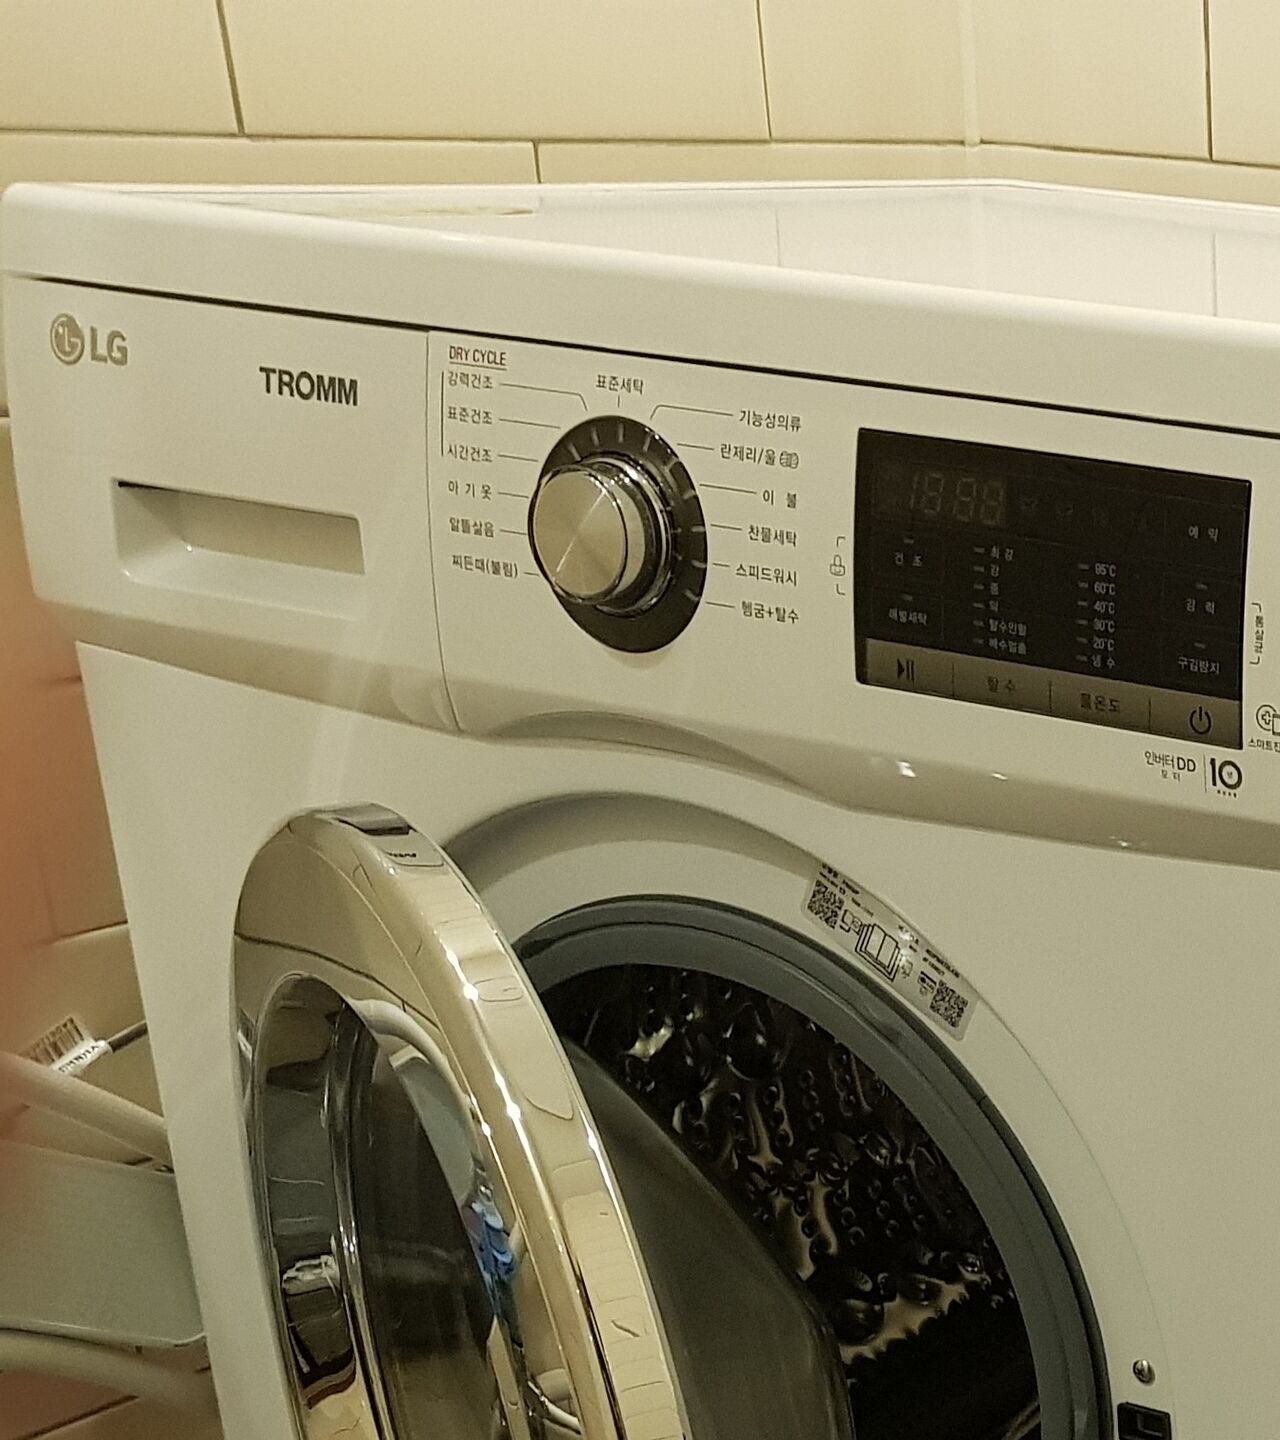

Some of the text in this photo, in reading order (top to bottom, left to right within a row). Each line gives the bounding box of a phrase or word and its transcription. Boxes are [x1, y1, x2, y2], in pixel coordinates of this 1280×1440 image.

[90, 325, 128, 366] LG
[449, 345, 507, 366] DRY CYCLE
[259, 366, 358, 406] TROMM
[448, 371, 493, 389] 강력건조
[595, 375, 643, 395] 표준세탁
[447, 406, 492, 424] 표준건조
[739, 410, 801, 432] 기능성의류
[448, 445, 492, 463] 시간건조
[720, 443, 776, 466] 란제리/울
[748, 525, 797, 547] 찬물세탁
[736, 563, 797, 586] 스피드워시
